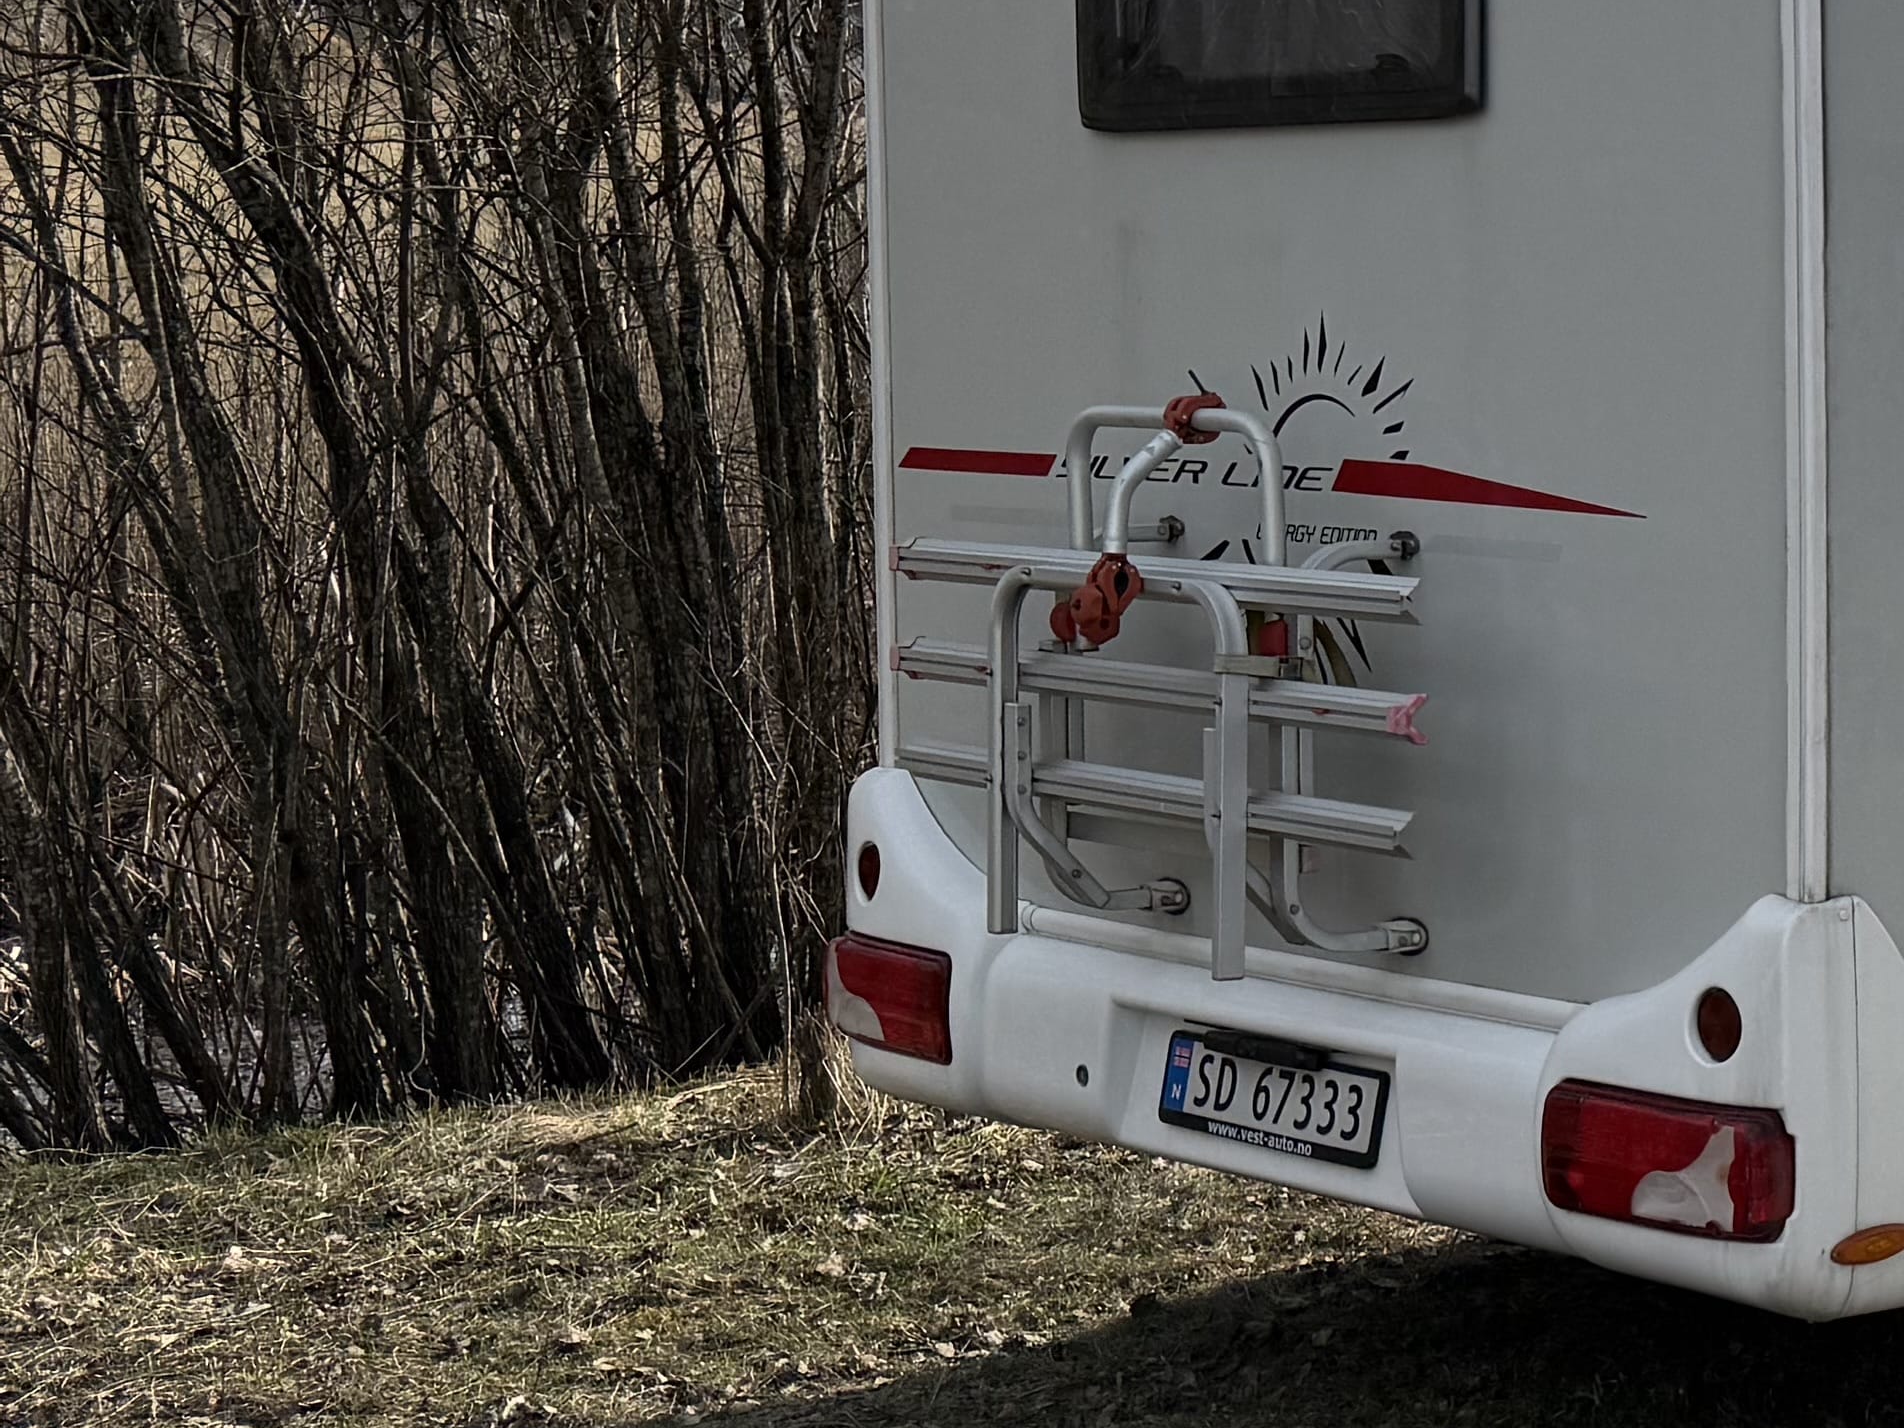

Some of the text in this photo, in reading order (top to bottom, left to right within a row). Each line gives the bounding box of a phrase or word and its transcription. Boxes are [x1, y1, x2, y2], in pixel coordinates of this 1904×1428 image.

[1171, 1083, 1182, 1101] N
[1193, 1054, 1363, 1141] SD 67333
[1208, 1121, 1313, 1157] www.vest-auto.no
